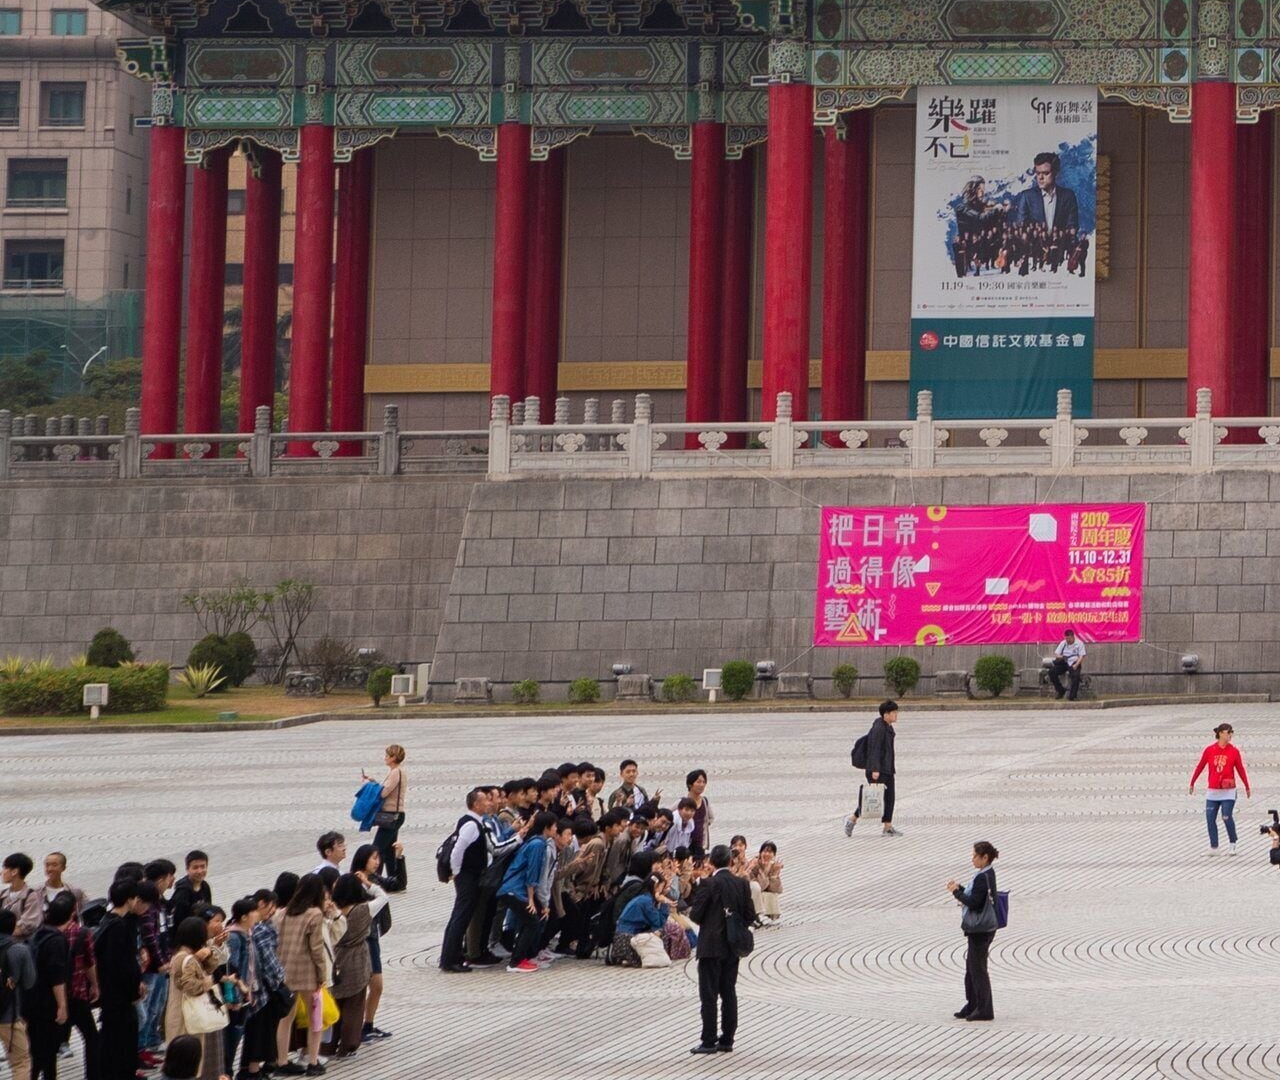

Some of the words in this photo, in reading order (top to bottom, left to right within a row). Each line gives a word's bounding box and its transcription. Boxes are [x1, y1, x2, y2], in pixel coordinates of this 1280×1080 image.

[927, 95, 996, 133] 樂躍
[1055, 100, 1093, 114] 新舞臺
[940, 281, 964, 291] 11.19
[978, 281, 1005, 291] 19:30
[943, 332, 1086, 348] 中國信託文教基金會
[1080, 511, 1109, 528] 2019
[829, 513, 919, 547] 把日常
[824, 555, 917, 589] 過得像
[1066, 566, 1131, 584] 入會85折
[822, 598, 886, 638] 藝術
